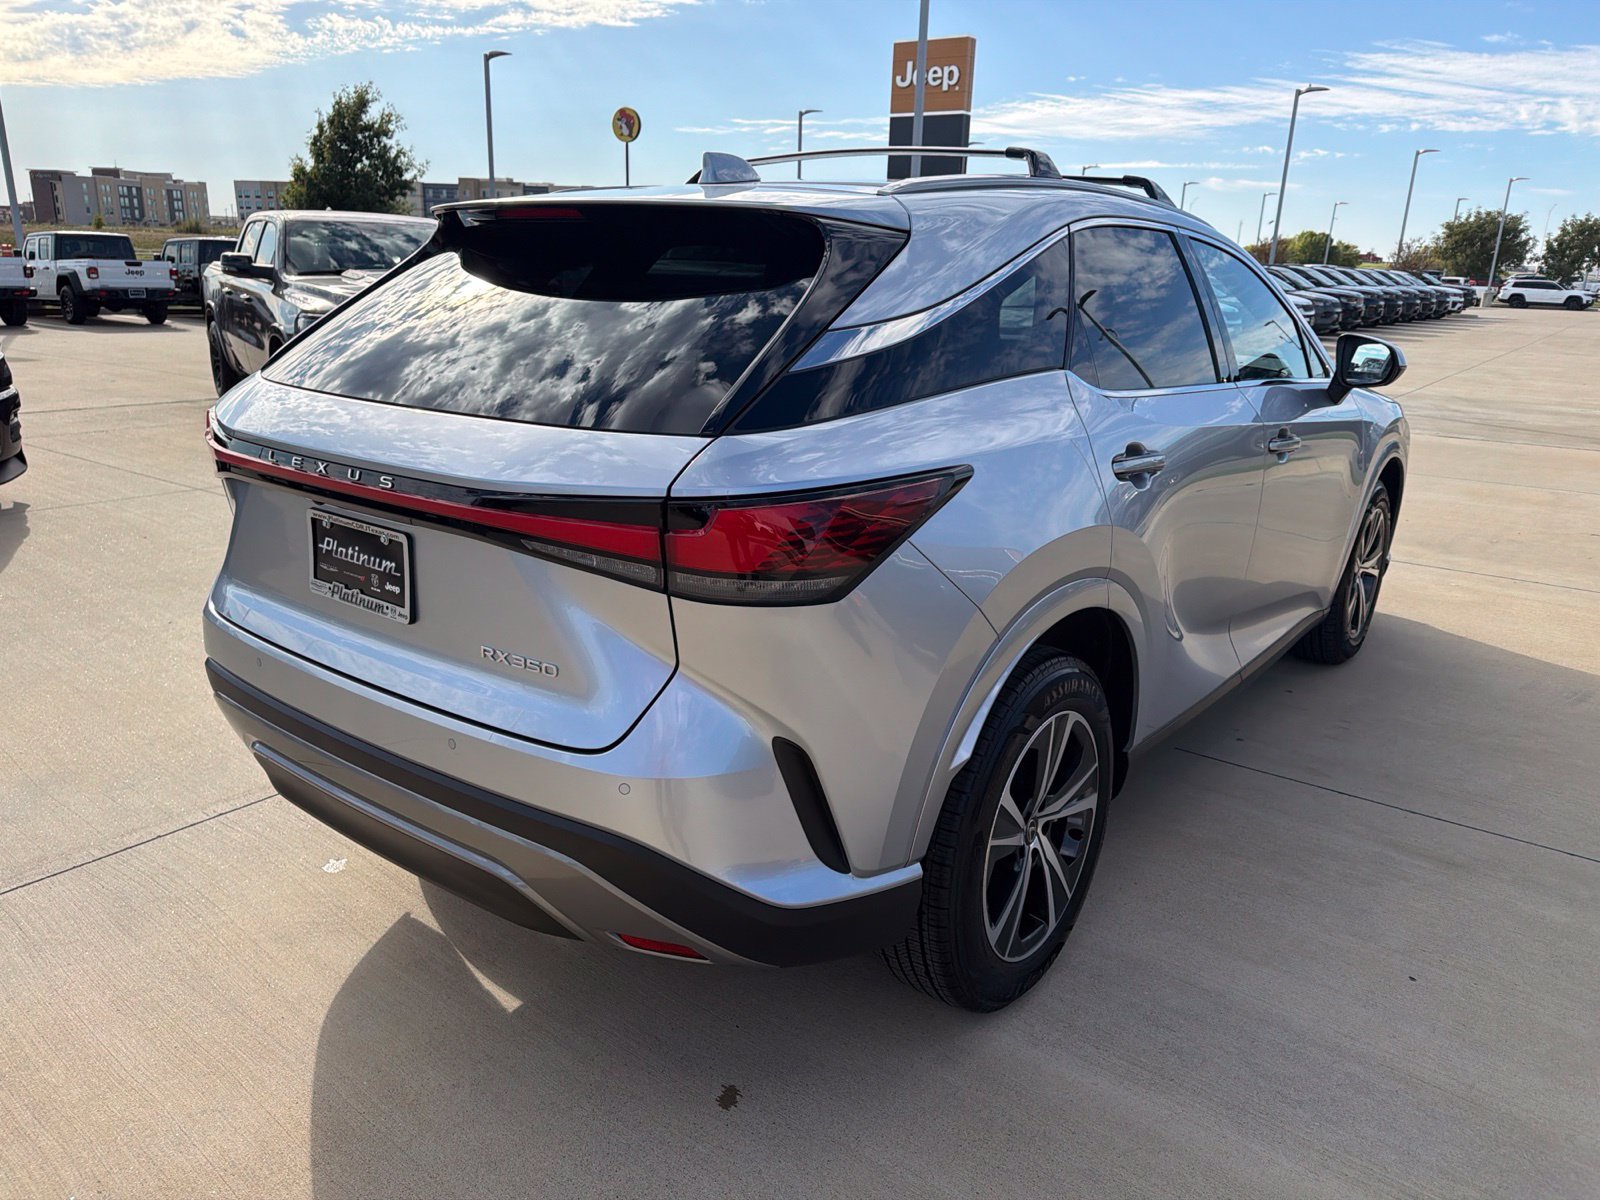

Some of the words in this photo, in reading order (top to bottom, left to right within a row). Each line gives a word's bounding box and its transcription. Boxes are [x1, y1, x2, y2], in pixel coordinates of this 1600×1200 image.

[125, 268, 145, 277] Jeep
[267, 450, 395, 489] LEXUS
[318, 537, 401, 576] Platinum
[331, 584, 389, 616] Platinum
[384, 581, 401, 595] Jeep
